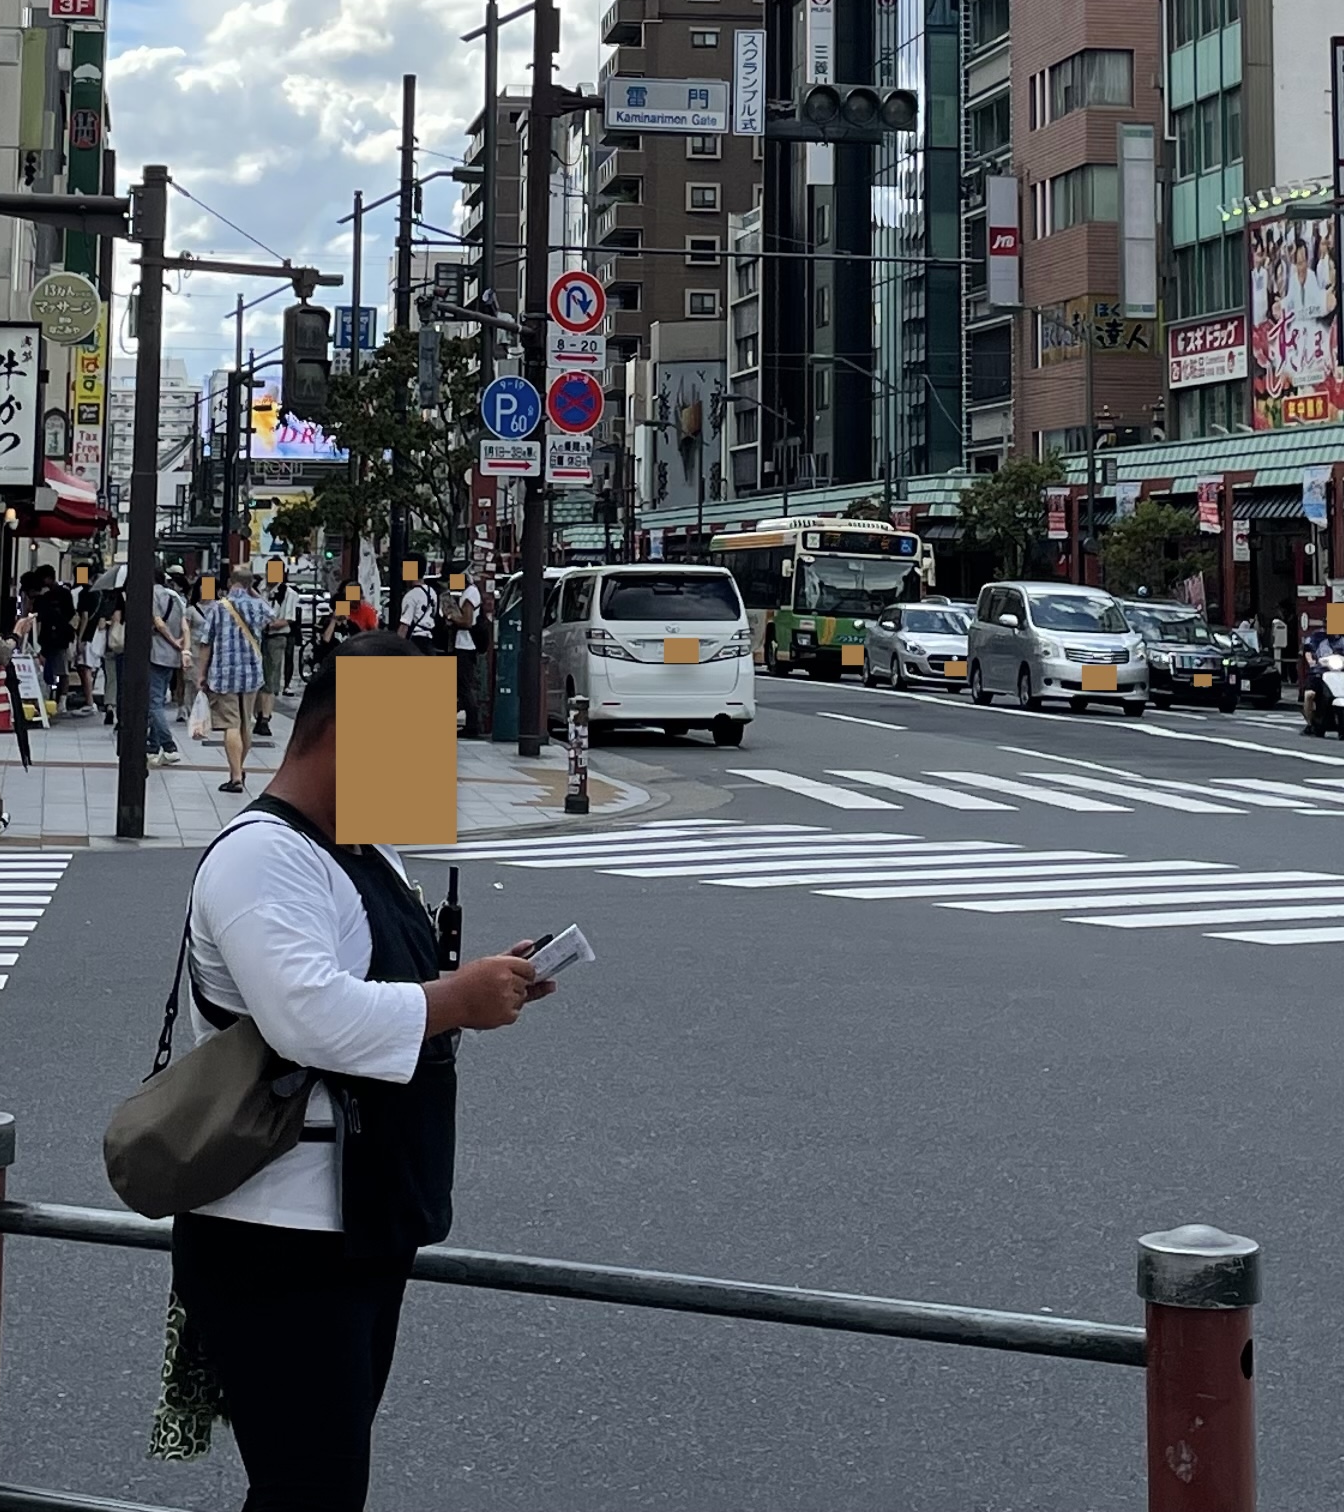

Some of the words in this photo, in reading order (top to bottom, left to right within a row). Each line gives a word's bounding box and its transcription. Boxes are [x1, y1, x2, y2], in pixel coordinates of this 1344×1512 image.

[626, 85, 710, 110] 雷門
[615, 110, 688, 127] Kaminarimon
[691, 113, 718, 128] Gate
